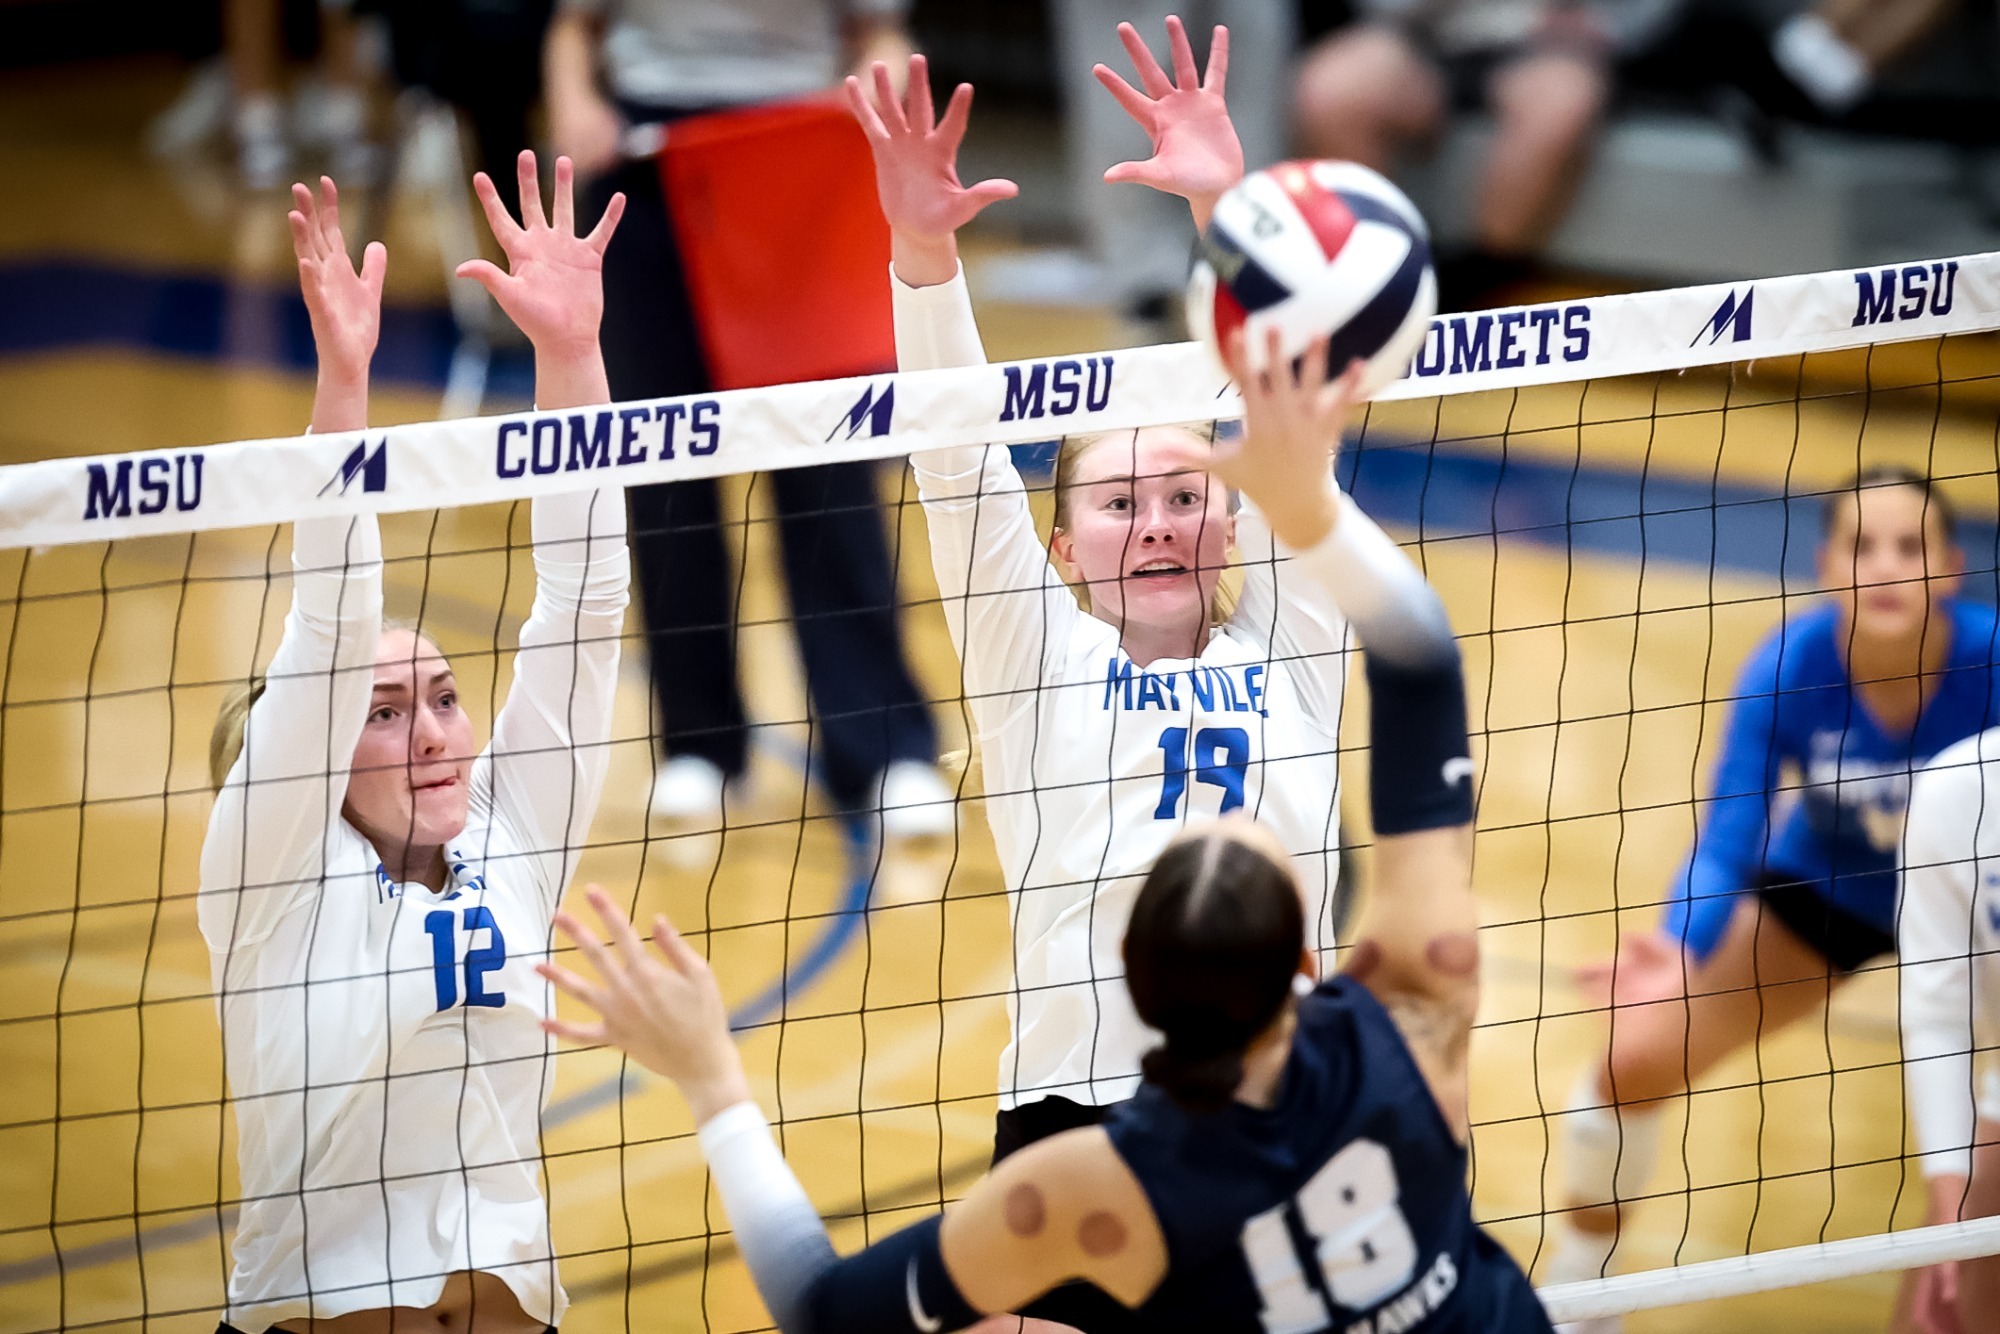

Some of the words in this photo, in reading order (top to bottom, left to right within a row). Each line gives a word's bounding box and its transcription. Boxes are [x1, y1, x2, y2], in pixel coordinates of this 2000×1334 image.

[84, 454, 204, 520] MSU
[496, 401, 721, 478] COMETS
[999, 357, 1114, 421] MSU
[1398, 305, 1591, 380] OMETS
[1852, 261, 1959, 326] MSU
[1153, 726, 1250, 820] 19
[424, 906, 507, 1012] 12
[1240, 1137, 1418, 1334] 18
